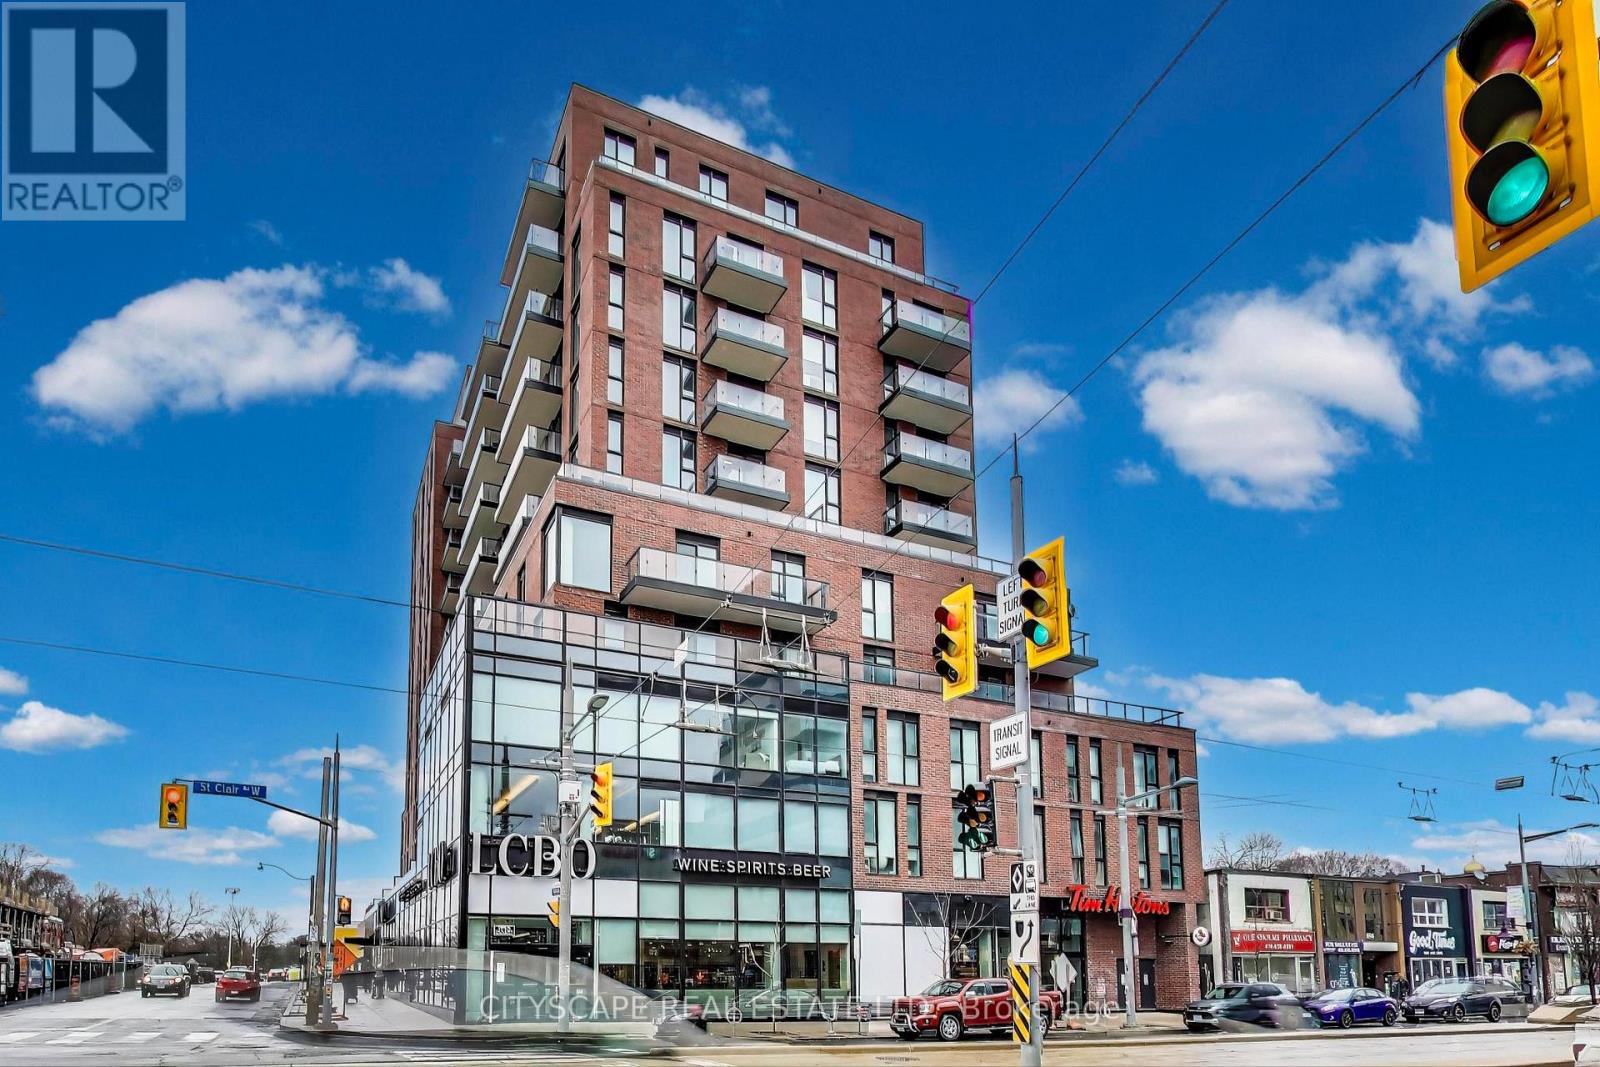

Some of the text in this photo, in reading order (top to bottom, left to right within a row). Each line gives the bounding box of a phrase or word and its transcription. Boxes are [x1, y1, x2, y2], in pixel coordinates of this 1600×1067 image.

[1003, 596, 1022, 615] TUR
[993, 721, 1024, 743] TRANSIT
[995, 741, 1022, 761] SIGNAL
[200, 782, 210, 793] St
[215, 783, 240, 795] Clair
[251, 786, 261, 796] W
[470, 832, 597, 880] LCBO
[677, 857, 832, 878] WINE SPIRITS BEER
[1066, 883, 1103, 913] Tim
[1409, 930, 1434, 955] Good
